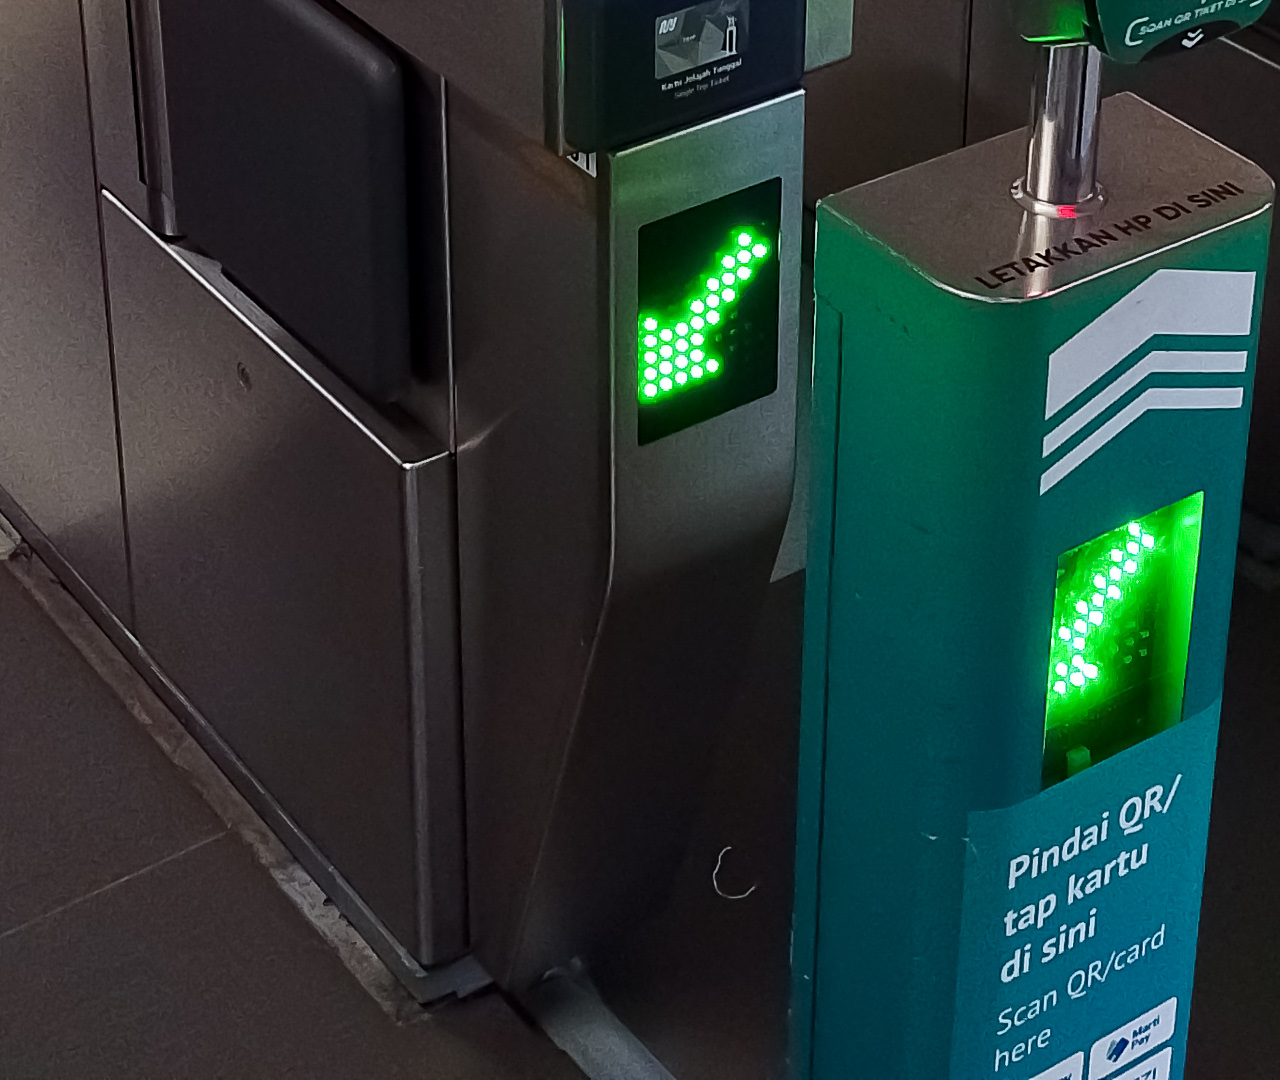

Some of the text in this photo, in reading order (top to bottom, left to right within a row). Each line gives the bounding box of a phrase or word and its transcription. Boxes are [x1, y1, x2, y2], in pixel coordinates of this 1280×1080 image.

[1138, 17, 1172, 35] SCAN
[1174, 12, 1192, 25] QR
[1194, 0, 1224, 19] TIKET
[974, 181, 1245, 290] LETAKKAN HP DI SINI
[1007, 773, 1183, 891] Pindai QR/
[1003, 842, 1150, 938] tap kartu
[996, 922, 1166, 1037] Scan QR/card
[1000, 907, 1098, 984] di sini
[994, 1027, 1052, 1073] here
